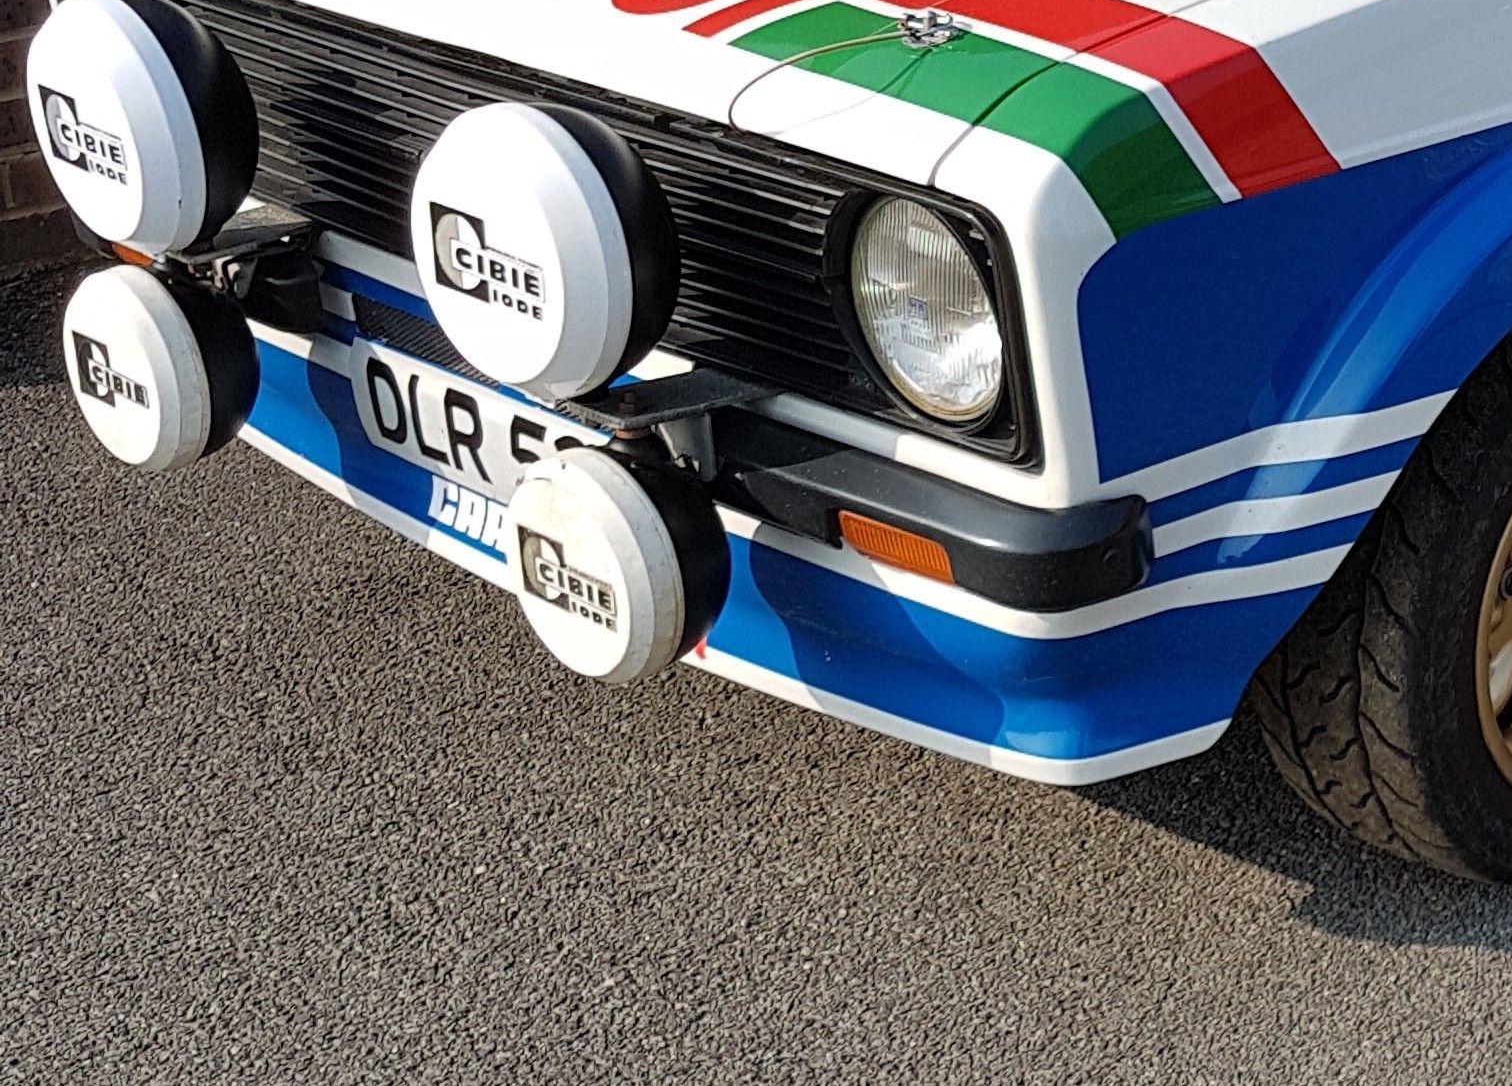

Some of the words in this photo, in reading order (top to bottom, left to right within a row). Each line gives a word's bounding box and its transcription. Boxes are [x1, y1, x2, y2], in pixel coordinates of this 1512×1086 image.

[60, 122, 123, 165] CIBIE
[455, 246, 541, 298] CIBIE
[365, 356, 493, 485] DLR
[509, 412, 588, 466] 5
[538, 563, 613, 612] CIBIE
